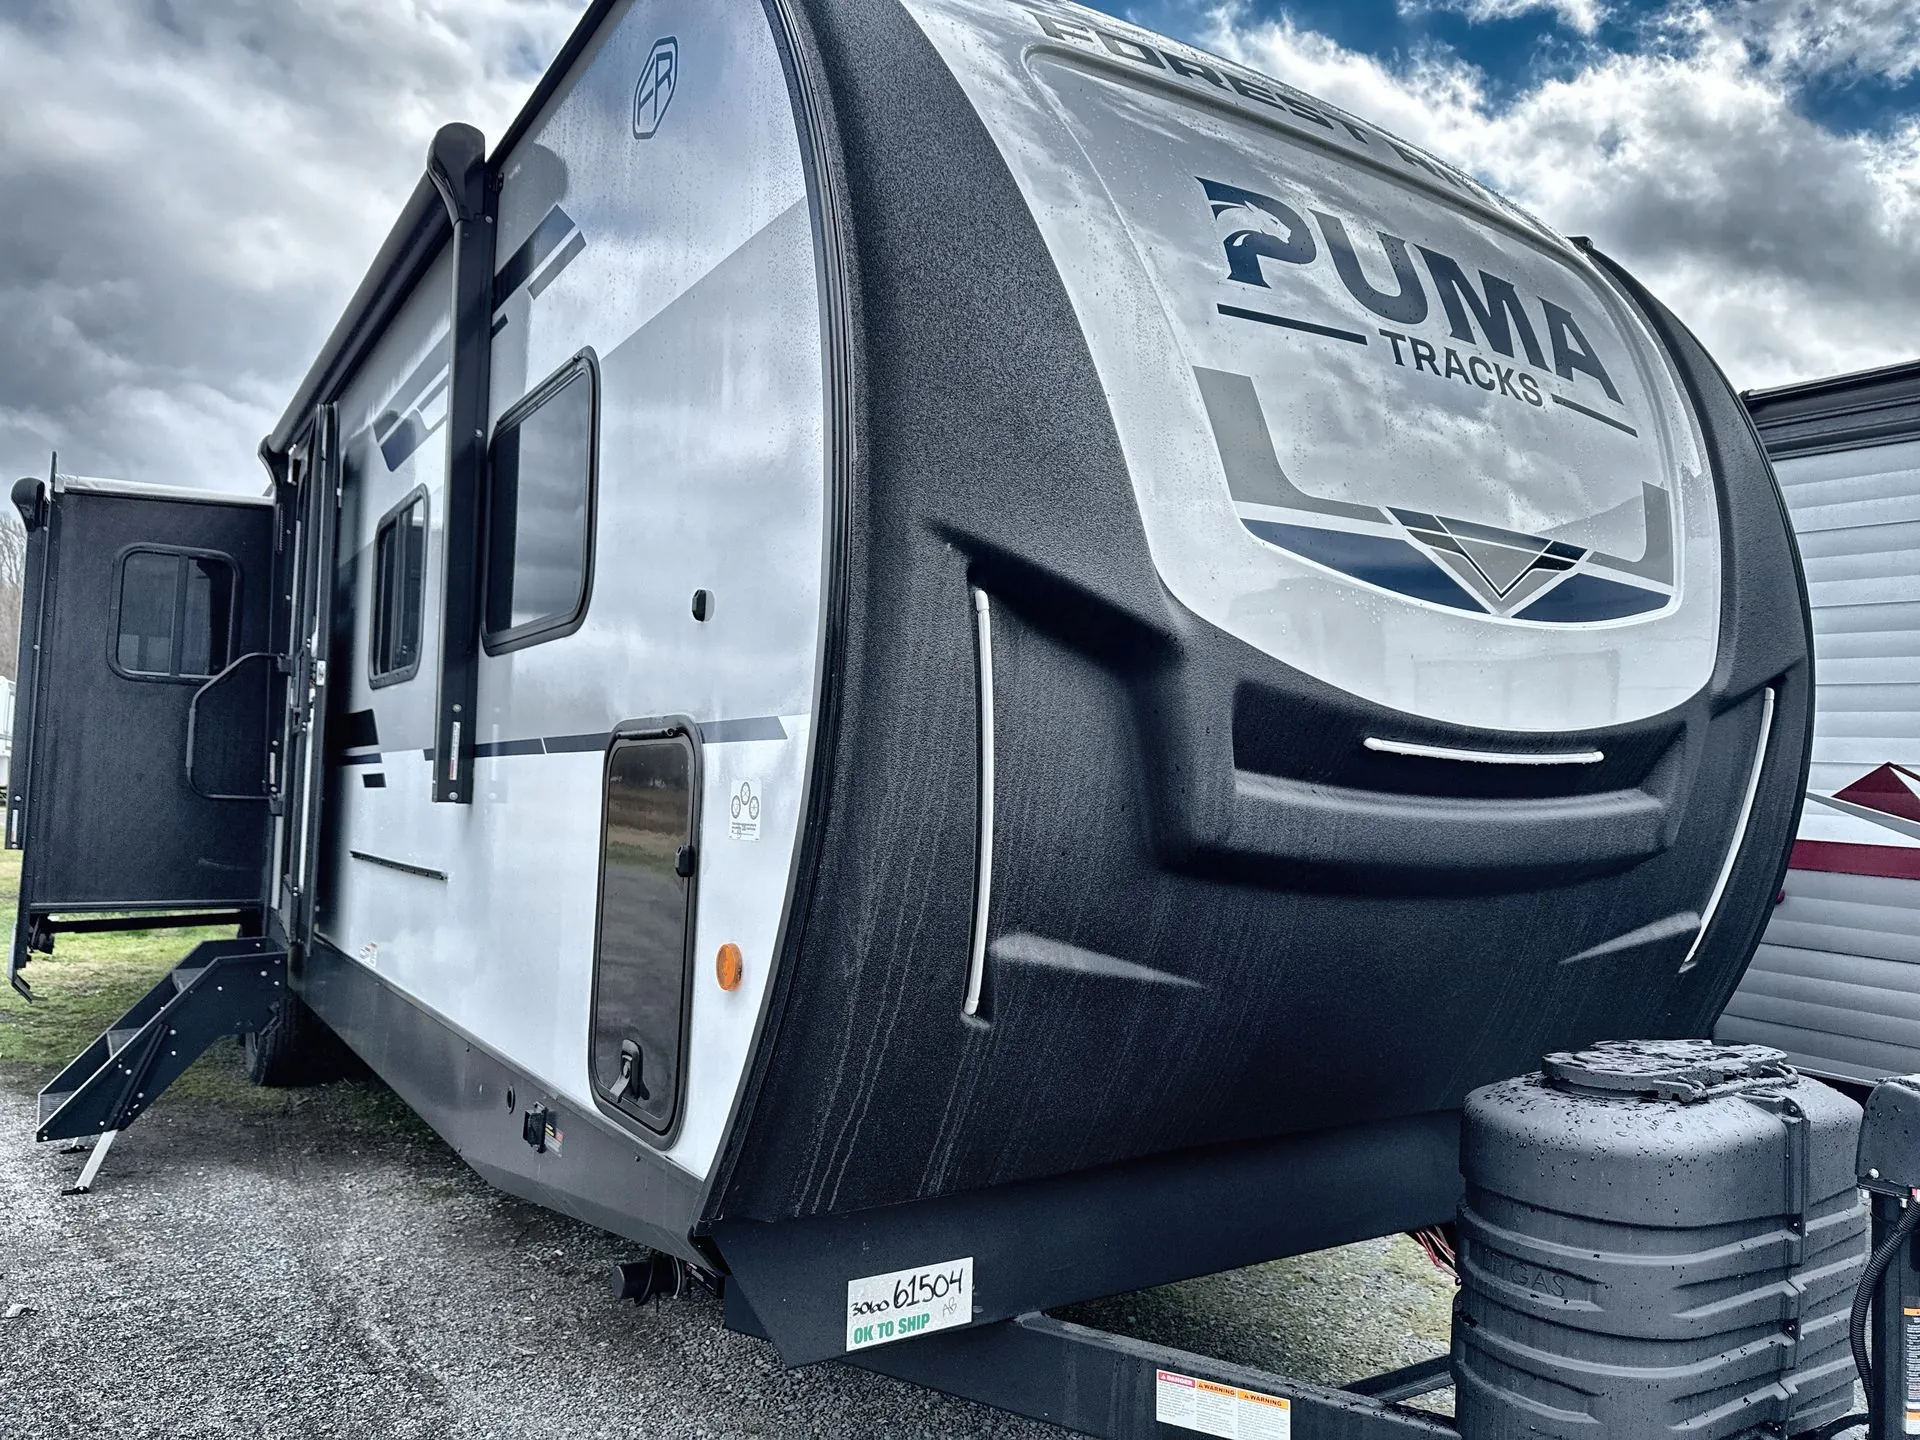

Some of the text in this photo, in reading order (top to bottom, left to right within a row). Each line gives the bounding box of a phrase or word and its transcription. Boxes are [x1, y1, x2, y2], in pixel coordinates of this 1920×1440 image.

[1030, 11, 1369, 145] FOREST
[1194, 176, 1624, 405] PUMA
[1379, 328, 1545, 408] TRACKS
[893, 1267, 964, 1309] 61504
[1510, 1263, 1564, 1297] GAS
[853, 1312, 931, 1345] OK TO SHIP
[1166, 1374, 1193, 1387] DANGER
[1204, 1383, 1235, 1396] WARNING
[1250, 1394, 1282, 1407] WARNING
